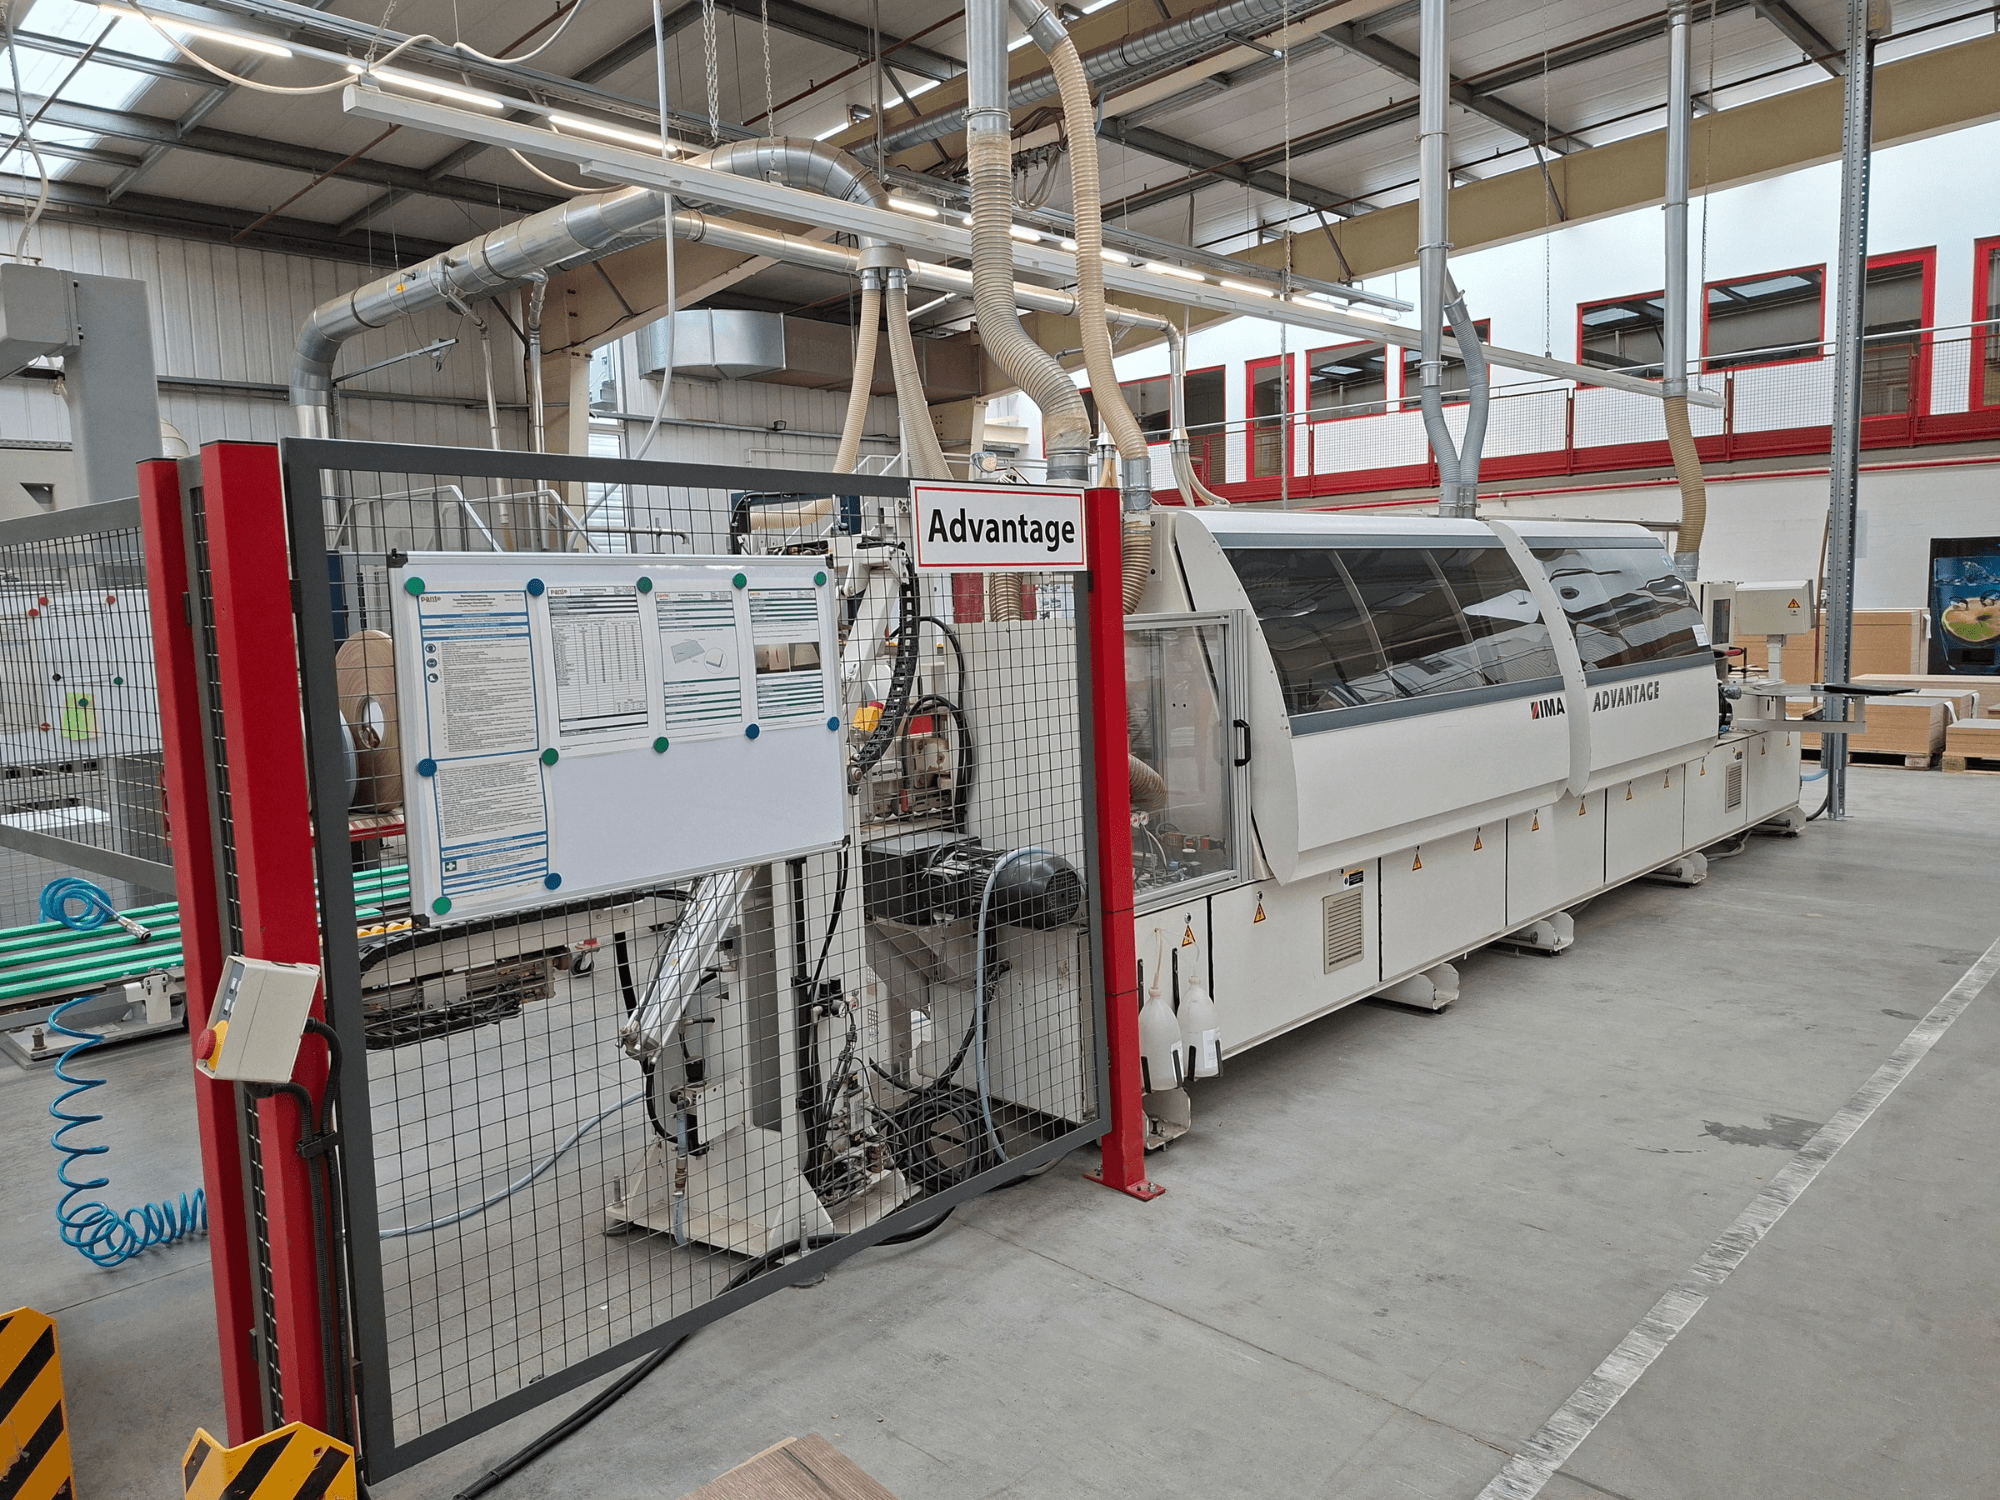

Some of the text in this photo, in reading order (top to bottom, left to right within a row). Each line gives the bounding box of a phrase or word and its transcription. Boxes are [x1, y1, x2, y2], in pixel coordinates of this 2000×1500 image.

[928, 508, 1075, 552] Advantage
[420, 595, 442, 603] pante
[1538, 680, 1660, 719] IMA ADVANTAGE
